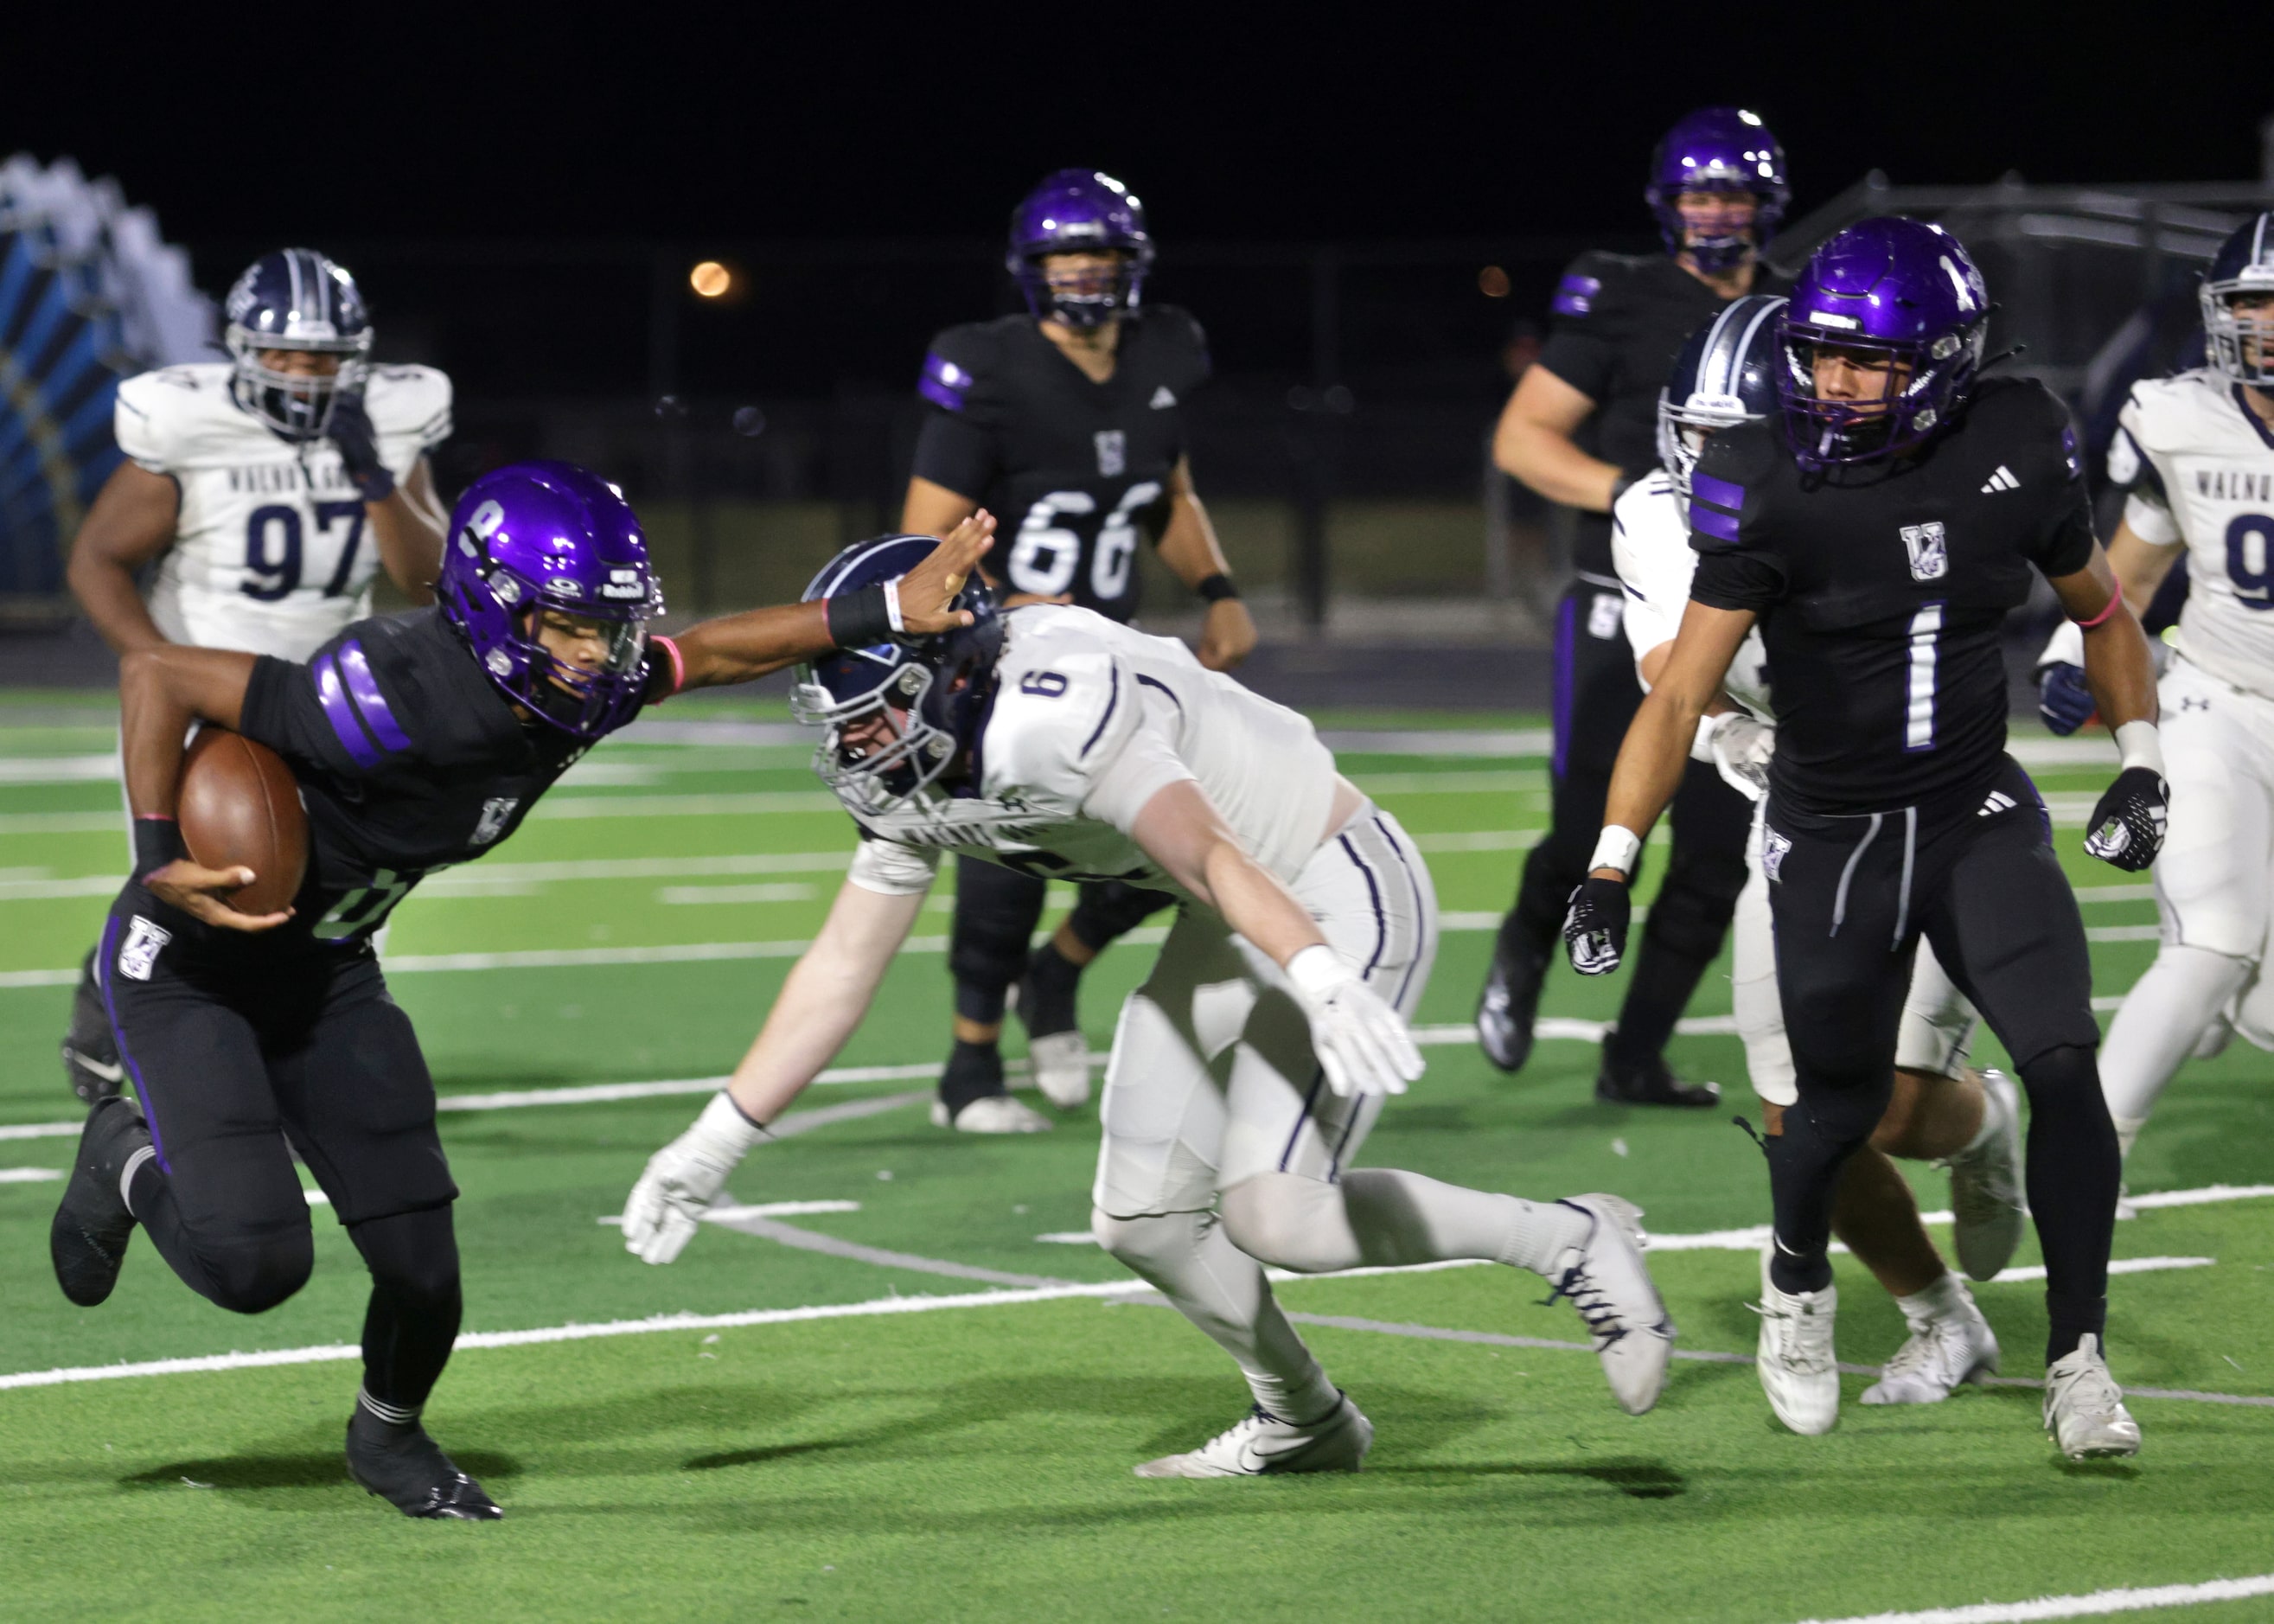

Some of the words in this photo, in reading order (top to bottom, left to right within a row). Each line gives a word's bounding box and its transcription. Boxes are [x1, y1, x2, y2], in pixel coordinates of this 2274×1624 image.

[240, 501, 367, 603] 97
[1008, 481, 1162, 600] 66
[2226, 514, 2274, 611] 9
[1905, 602, 1945, 750] 1
